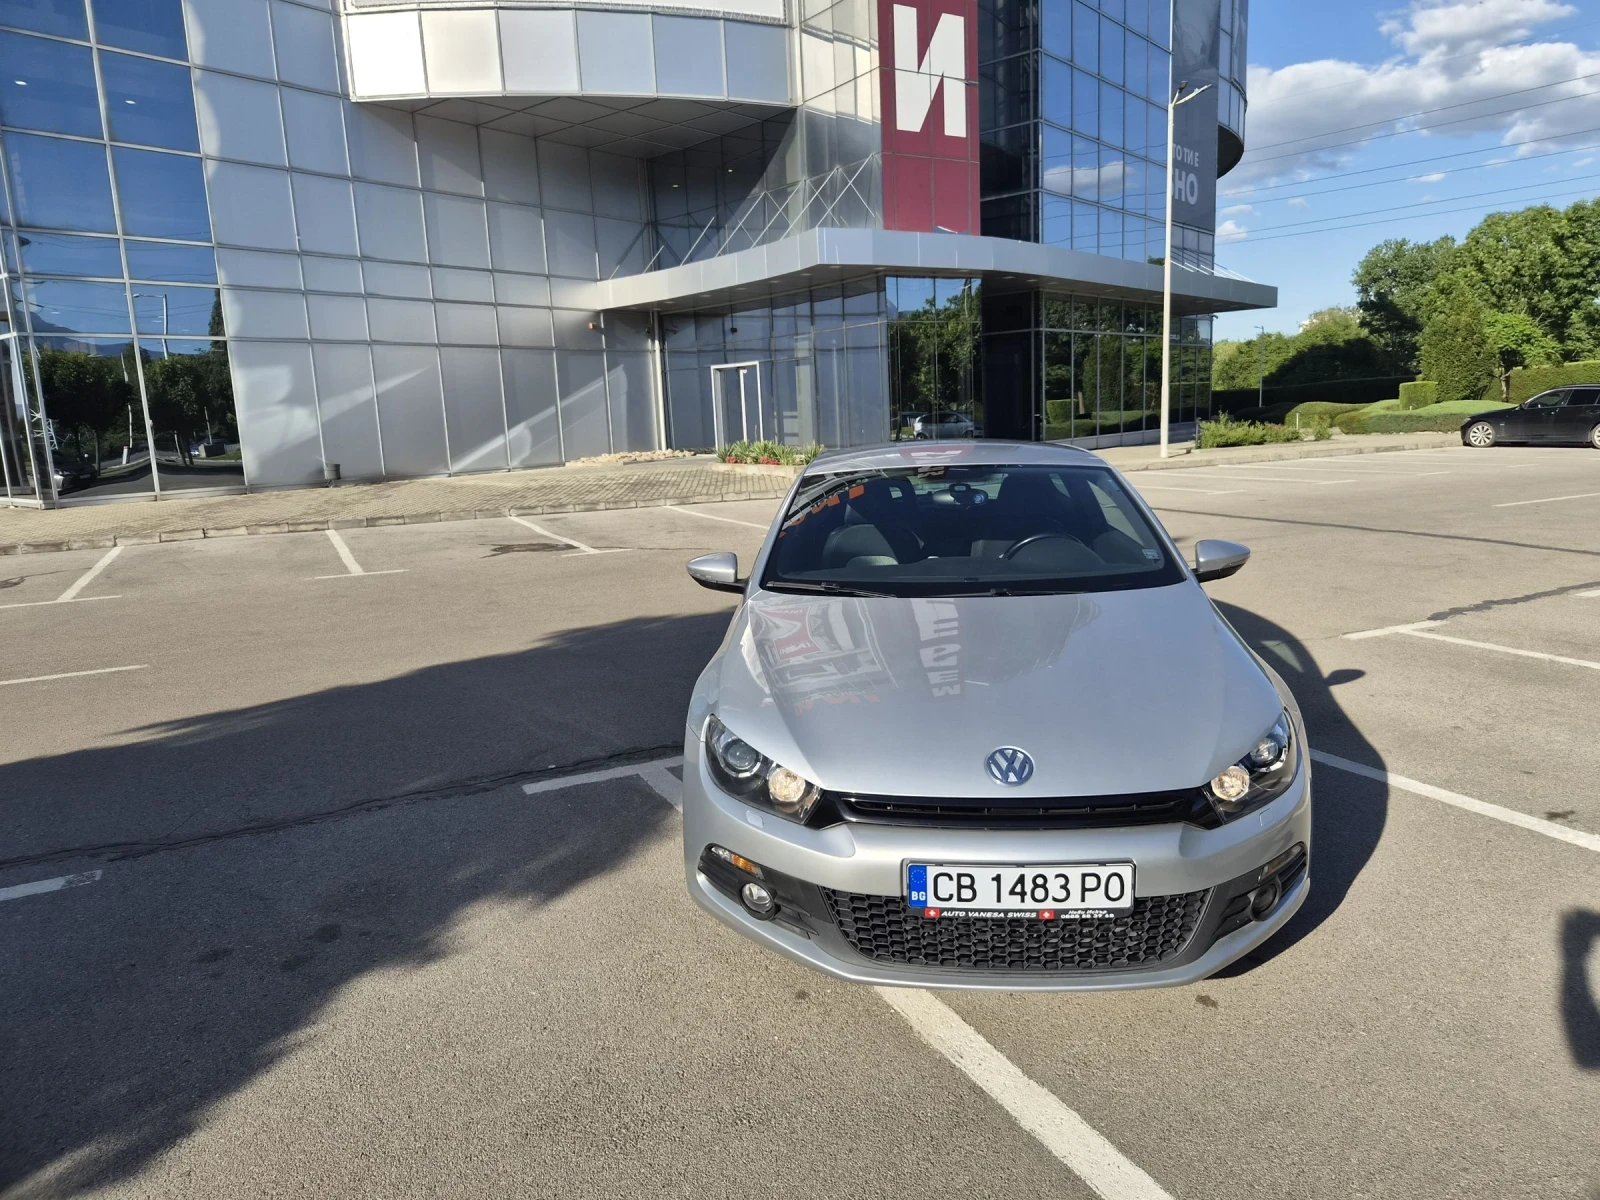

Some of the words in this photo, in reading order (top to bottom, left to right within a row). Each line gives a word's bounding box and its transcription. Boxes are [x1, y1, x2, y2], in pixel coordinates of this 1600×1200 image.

[911, 891, 926, 900] BG
[933, 872, 977, 902] CB
[991, 872, 1071, 903] 1483
